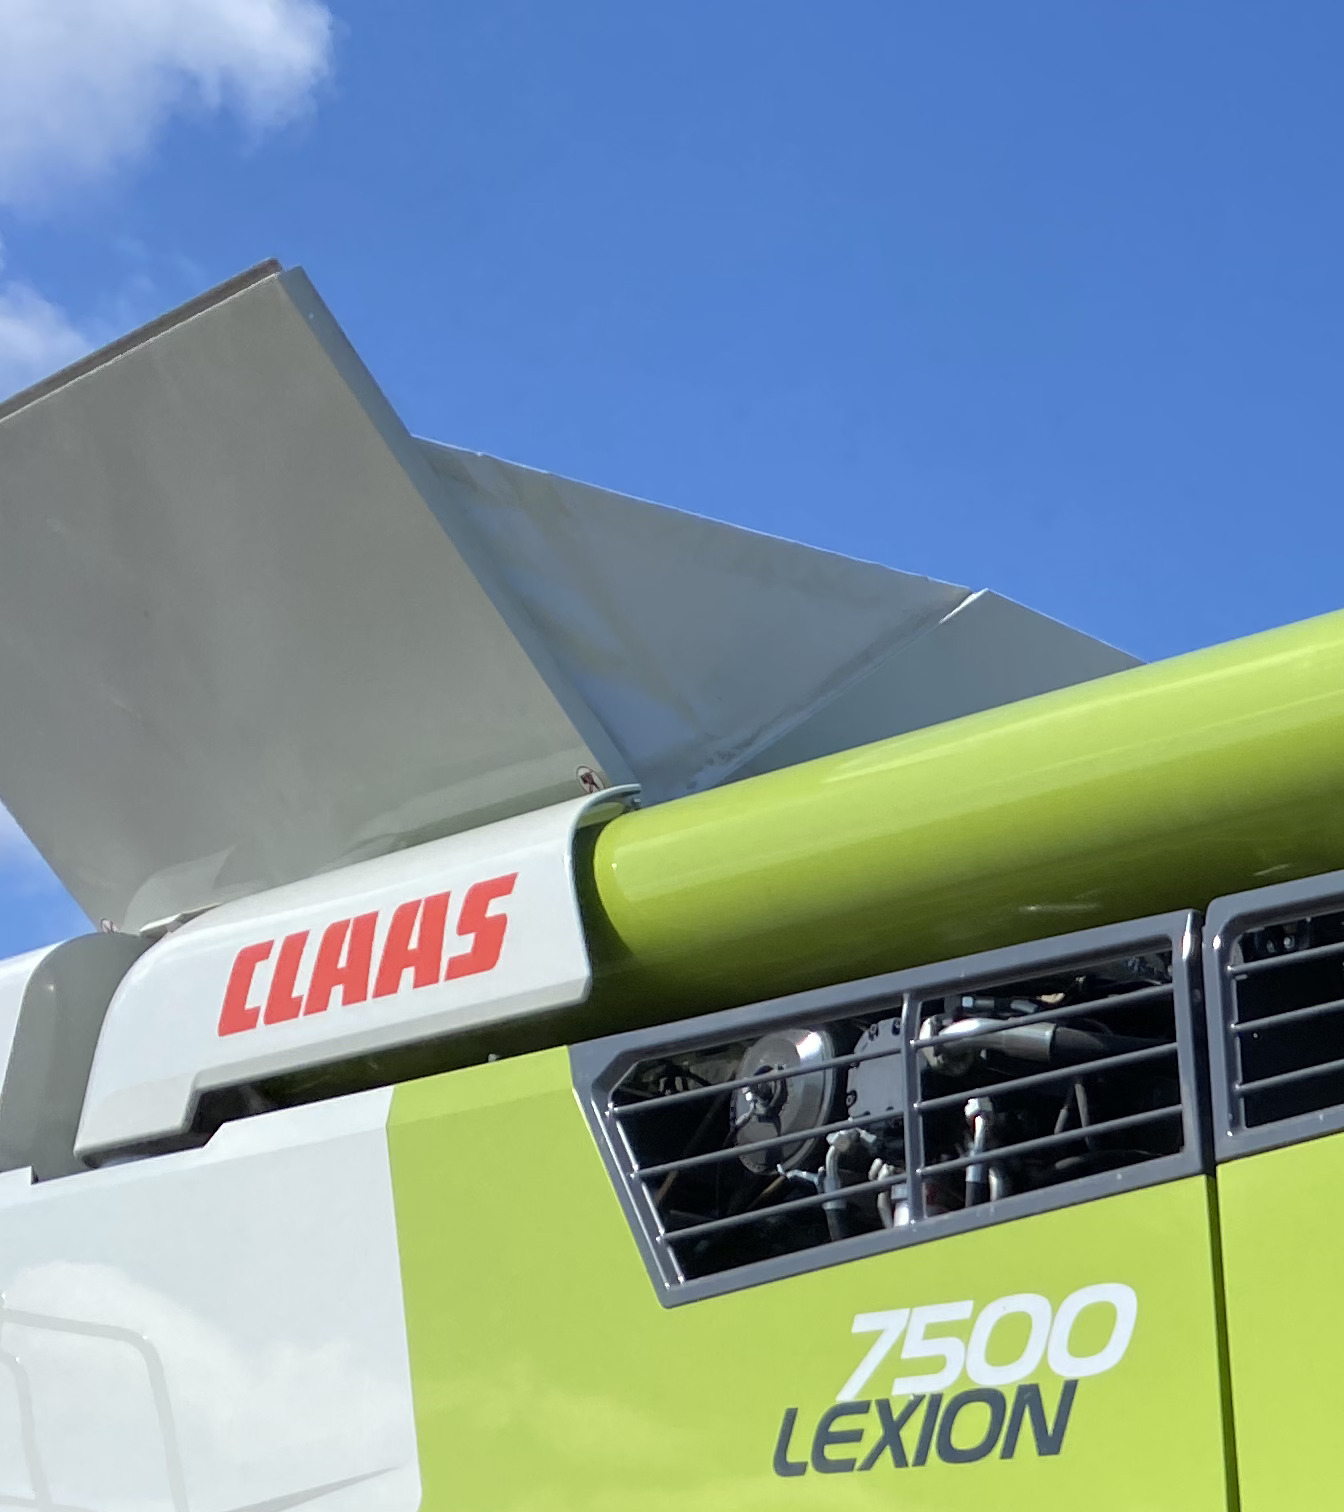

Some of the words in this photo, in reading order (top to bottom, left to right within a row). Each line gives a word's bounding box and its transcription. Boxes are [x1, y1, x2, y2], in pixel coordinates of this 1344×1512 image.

[217, 872, 519, 1037] CLAAS
[836, 1283, 1138, 1401] 7500
[772, 1379, 1079, 1477] LEXION
